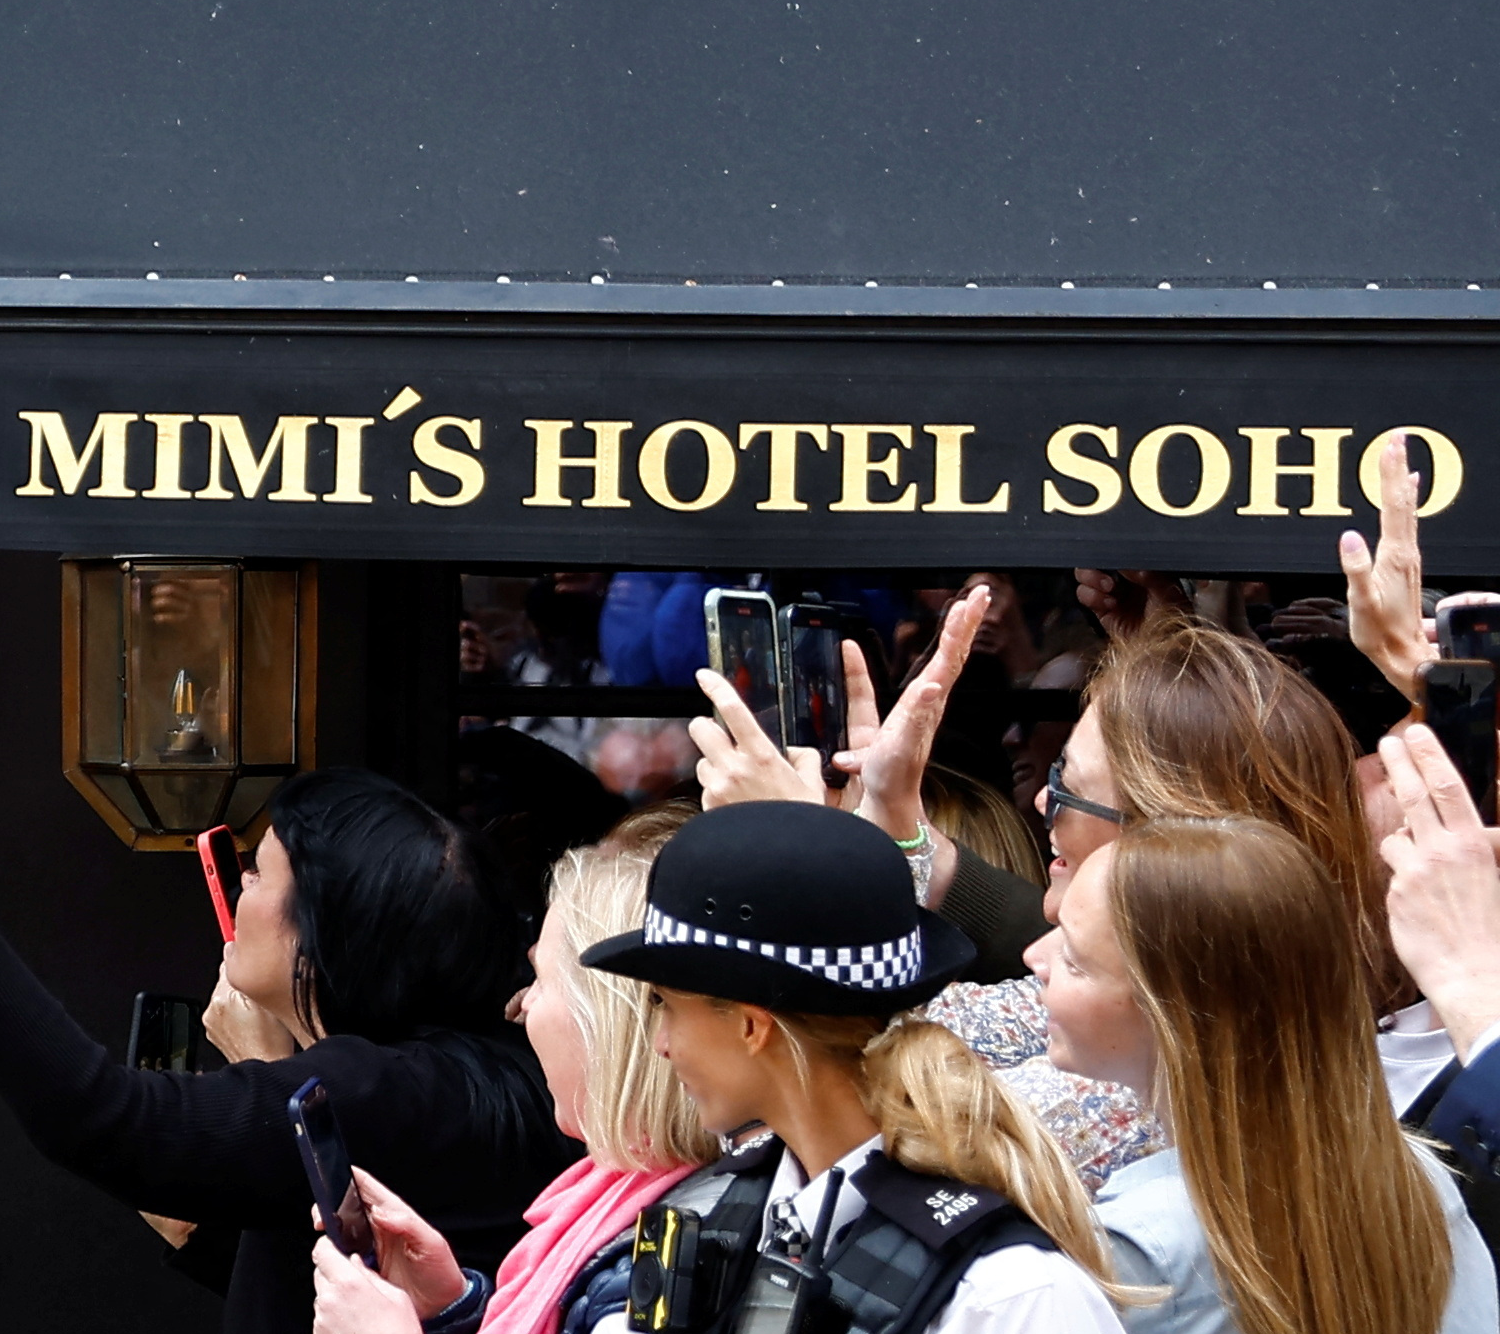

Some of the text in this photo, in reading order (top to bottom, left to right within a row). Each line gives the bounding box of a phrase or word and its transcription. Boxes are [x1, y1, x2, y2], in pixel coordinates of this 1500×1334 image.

[521, 418, 1011, 513] HOTEL
[1041, 422, 1465, 518] SOHO
[925, 1189, 955, 1209] SE
[932, 1192, 979, 1226] 2495
